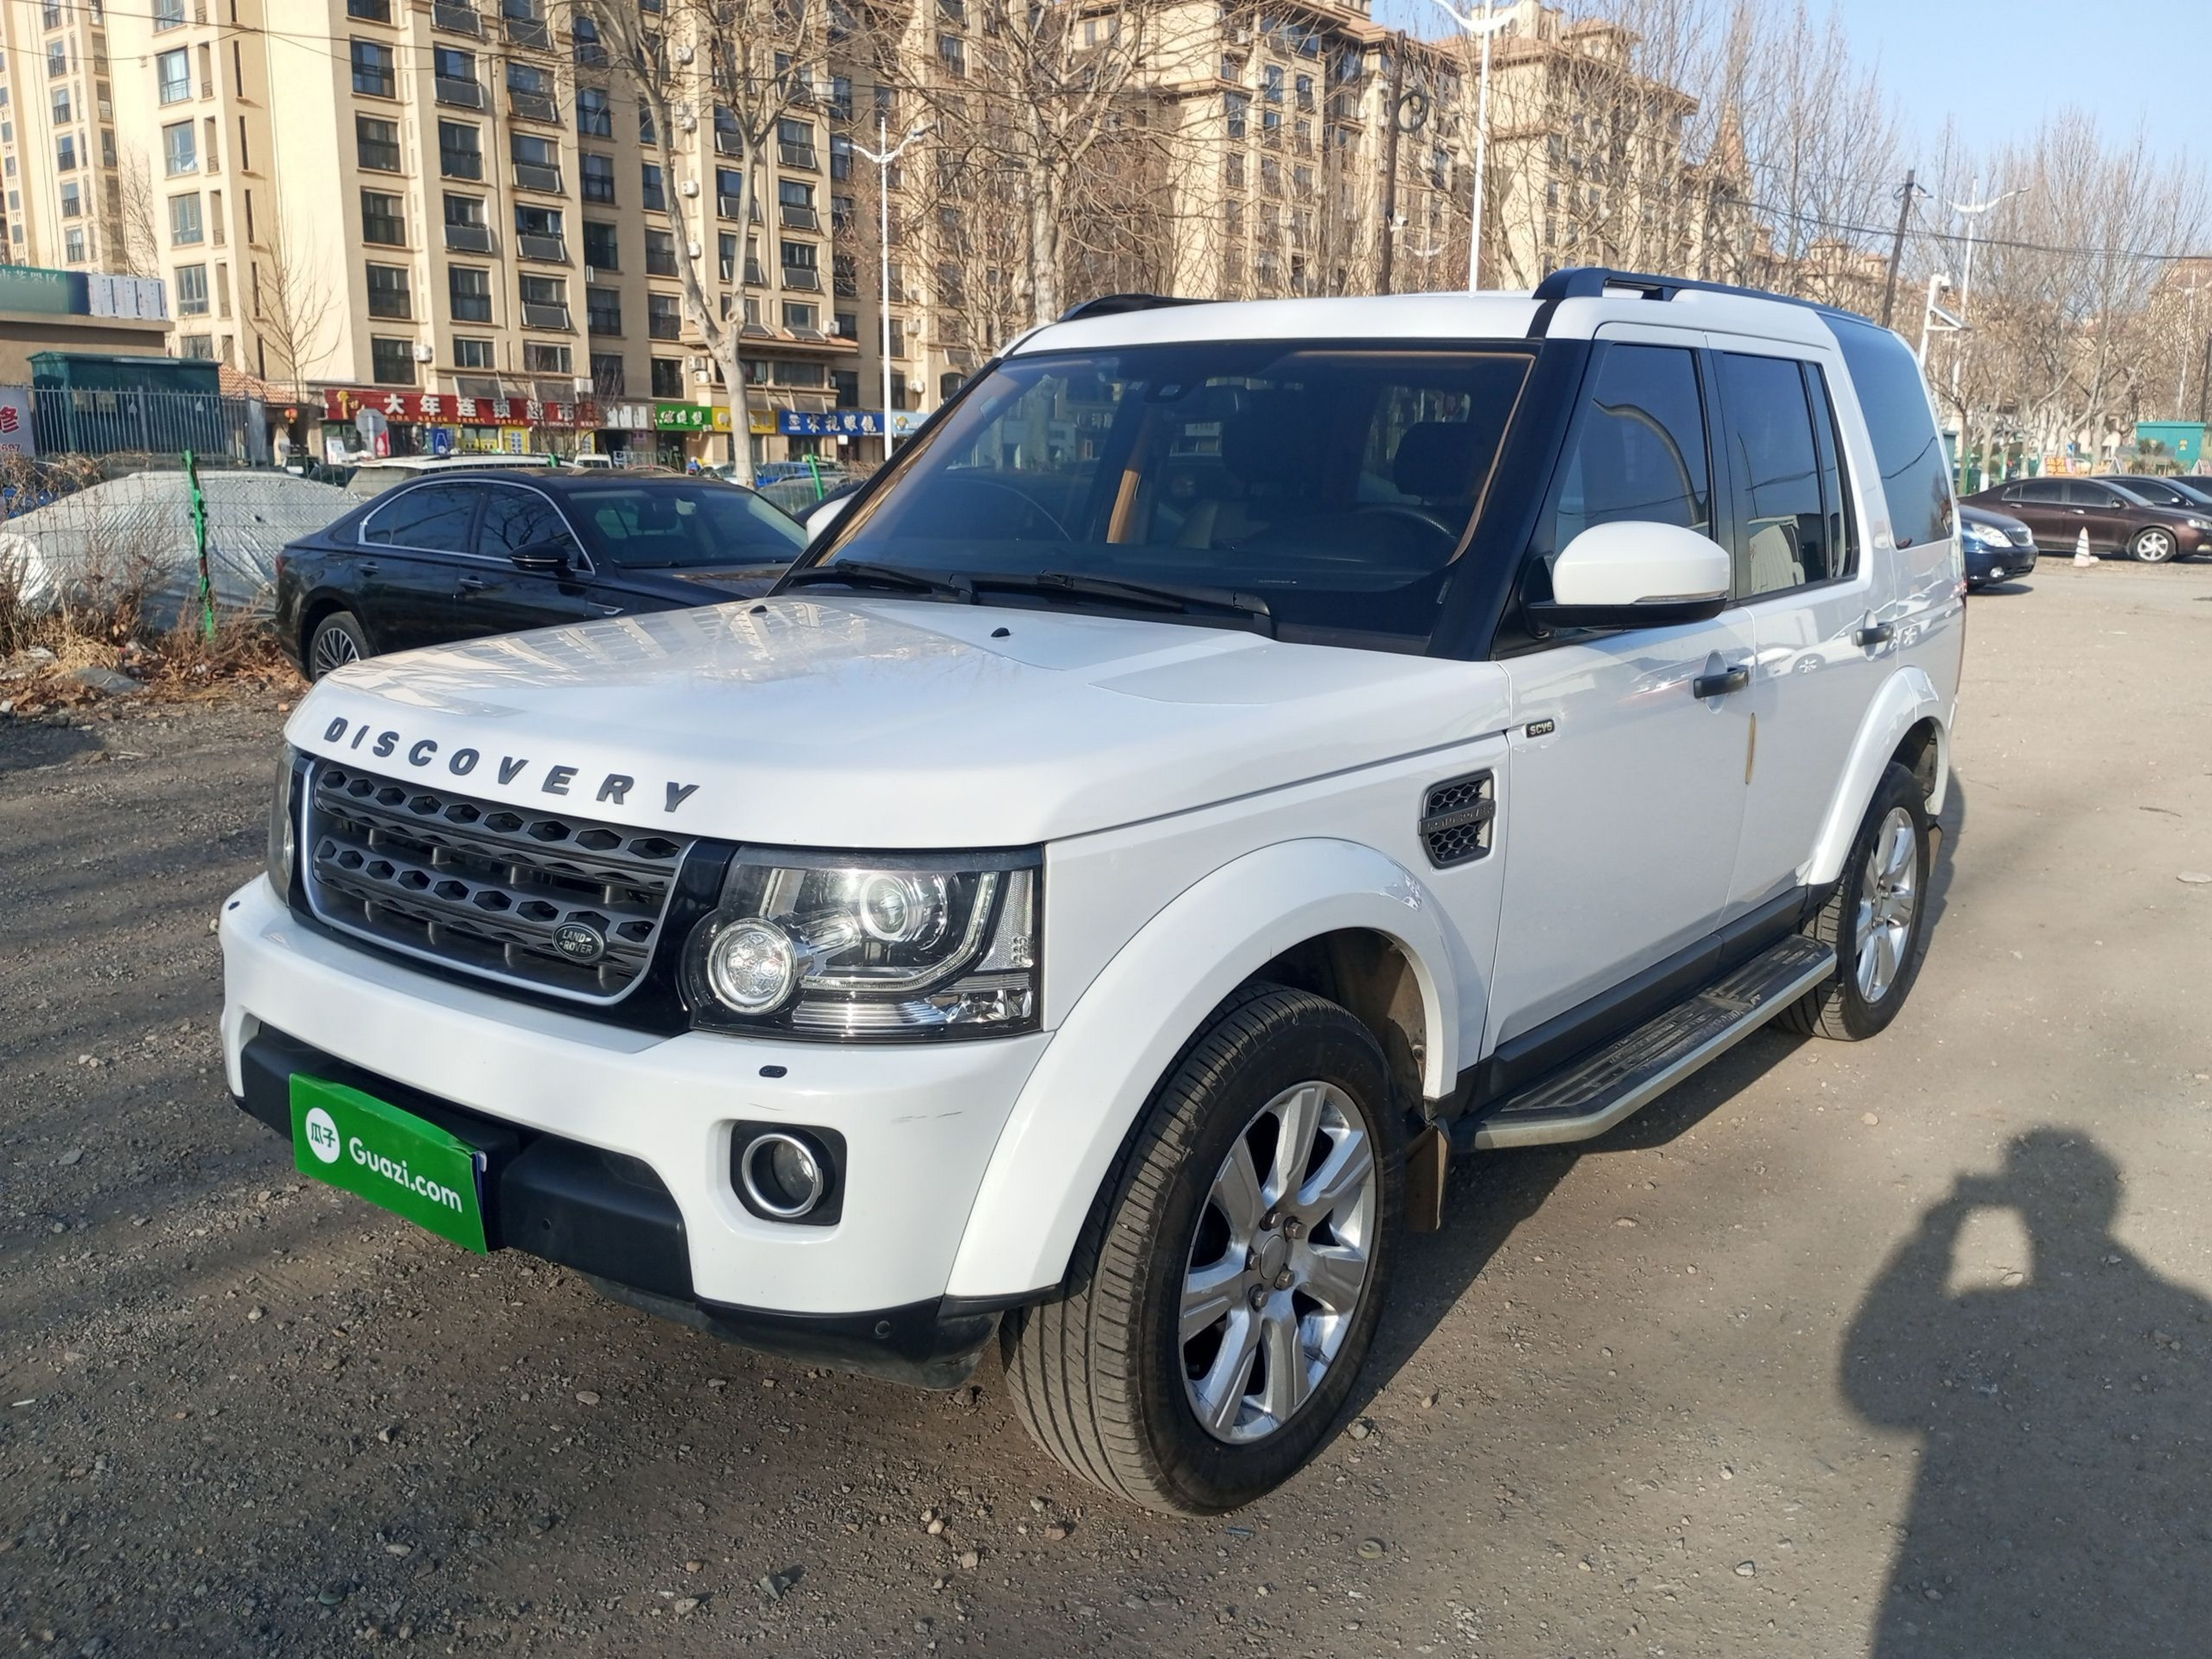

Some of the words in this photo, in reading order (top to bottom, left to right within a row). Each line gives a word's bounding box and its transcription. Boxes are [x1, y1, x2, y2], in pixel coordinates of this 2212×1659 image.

[1529, 721, 1553, 736] SCV6
[323, 717, 699, 812] DISCOVERY
[562, 929, 586, 943] LAND
[563, 940, 593, 955] ROVER
[310, 1122, 336, 1147] 瓜子
[349, 1137, 463, 1213] Guazi.com
